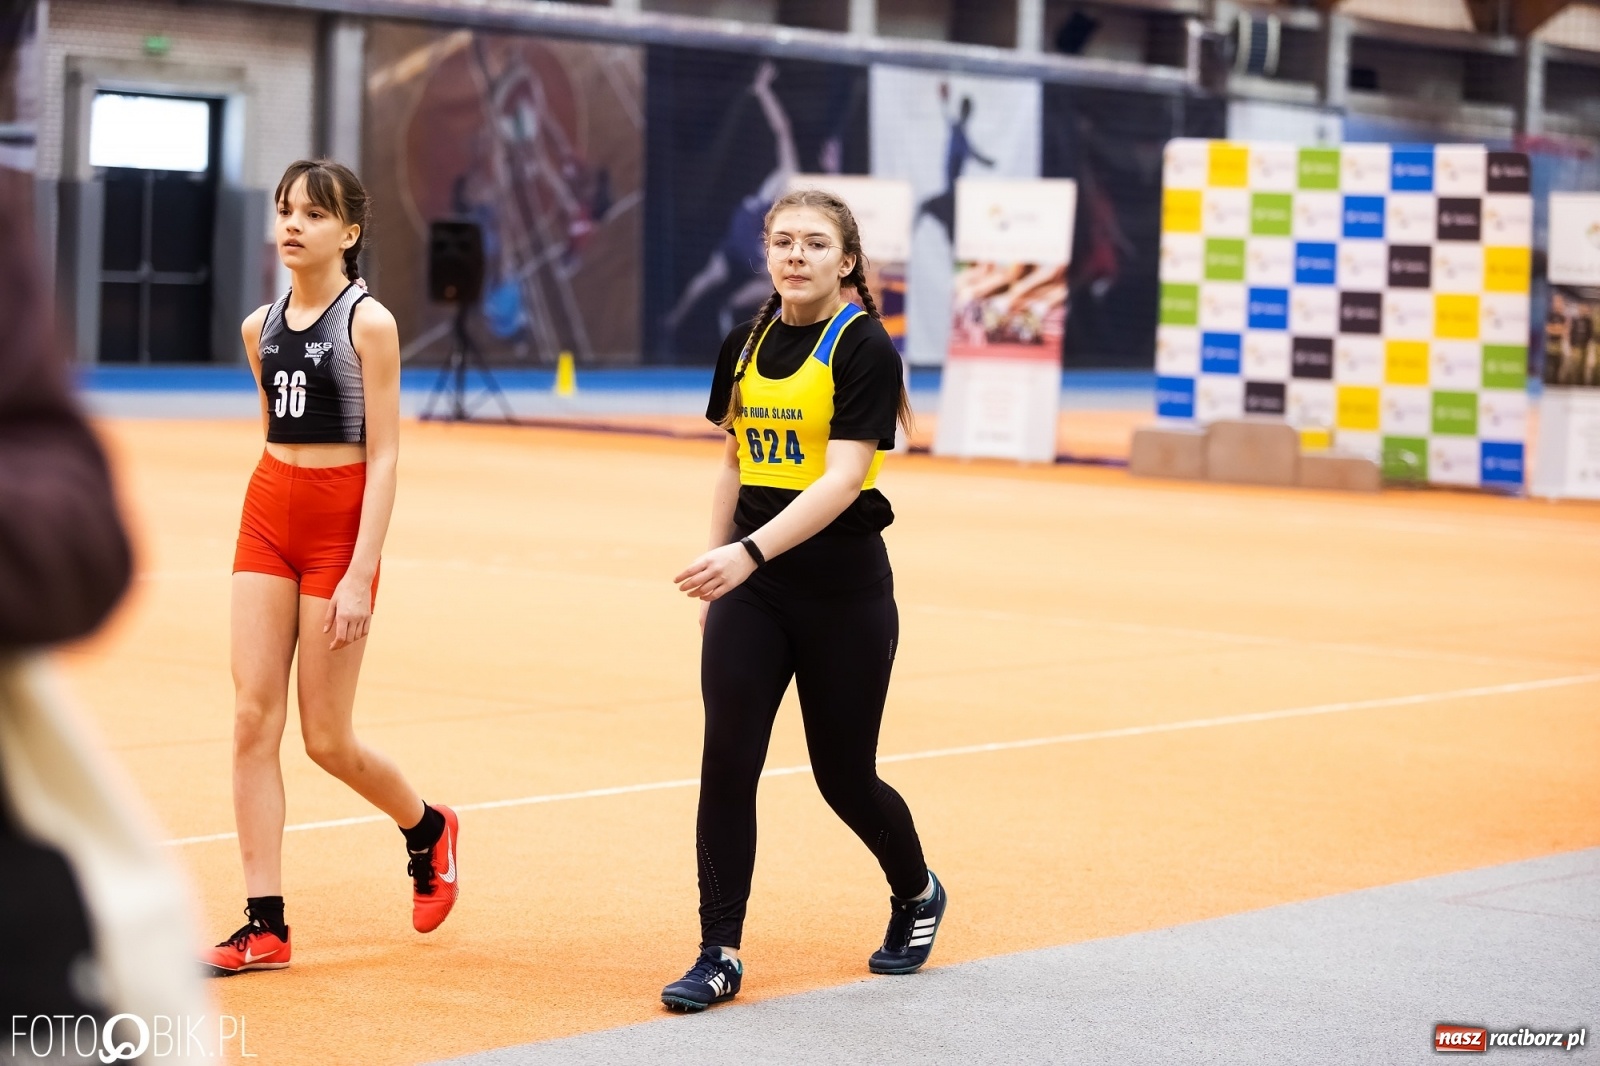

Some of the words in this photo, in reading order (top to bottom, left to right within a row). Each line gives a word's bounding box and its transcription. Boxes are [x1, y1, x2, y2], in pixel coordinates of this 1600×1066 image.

[273, 370, 306, 418] 36
[750, 407, 770, 418] RUDA
[772, 406, 803, 420] ŚLĄSKA
[746, 428, 804, 464] 624
